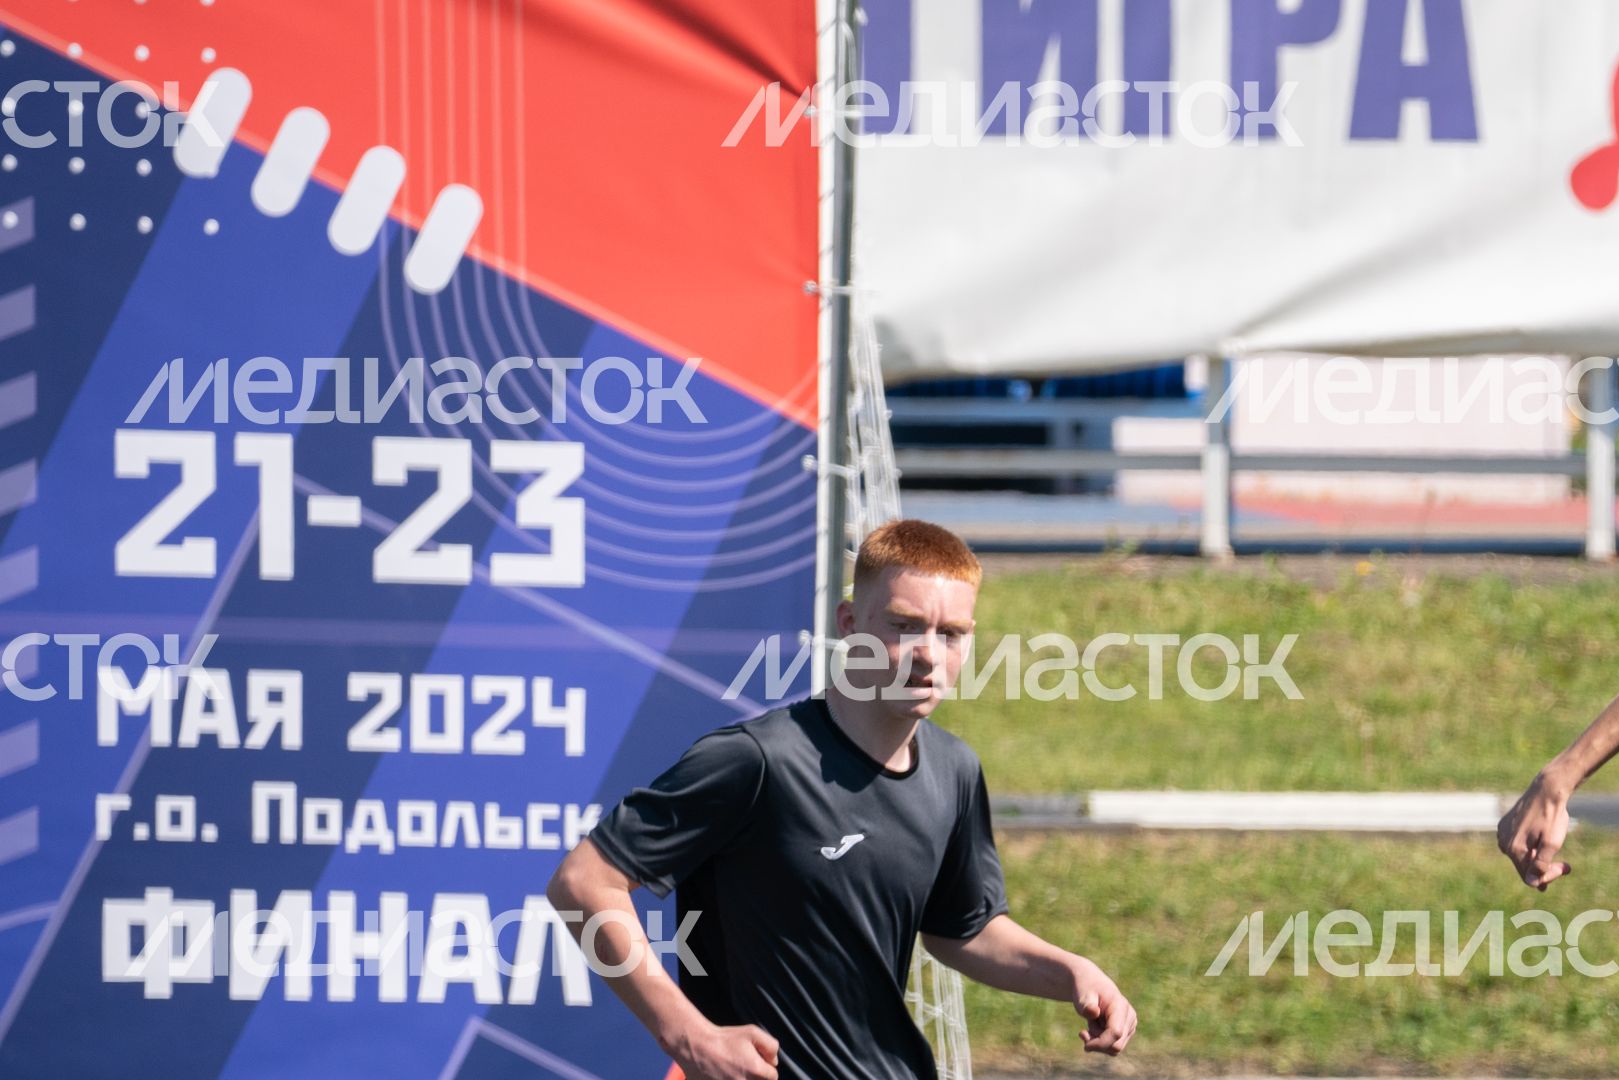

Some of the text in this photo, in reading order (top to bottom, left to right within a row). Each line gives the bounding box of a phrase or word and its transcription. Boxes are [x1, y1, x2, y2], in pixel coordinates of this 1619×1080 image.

[115, 430, 586, 588] 21-23
[96, 666, 587, 757] МАЯ 2024
[95, 780, 603, 854] г.о. Подольск
[102, 886, 593, 1007] ФИНАЛ
